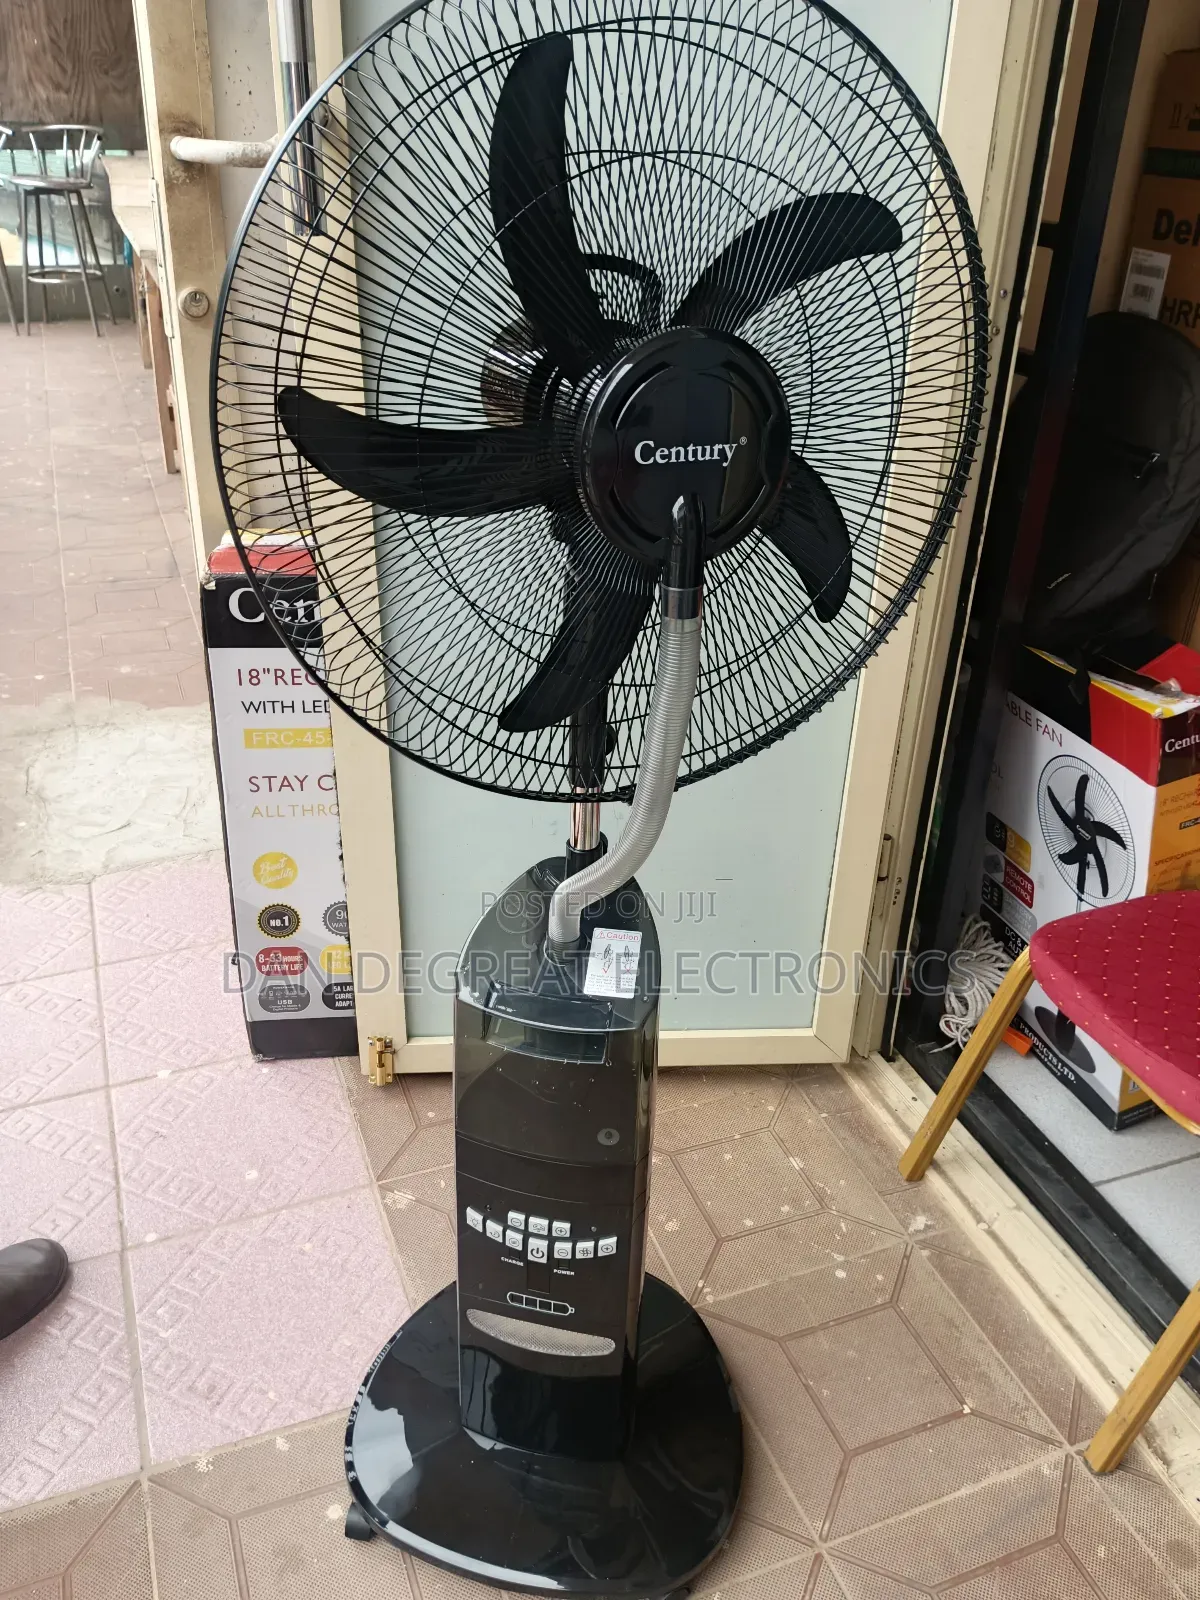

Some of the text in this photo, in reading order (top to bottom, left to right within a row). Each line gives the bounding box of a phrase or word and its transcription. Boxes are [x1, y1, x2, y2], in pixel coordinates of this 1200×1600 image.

[634, 440, 738, 467] Century
[241, 700, 295, 714] WITH
[1036, 717, 1063, 748] FAN
[248, 774, 334, 793] STAY C
[1006, 865, 1033, 893] REMOTE
[1005, 876, 1032, 904] CONTROL
[269, 915, 289, 927] NO.1
[606, 931, 639, 941] Caution
[1005, 926, 1016, 941] DC
[261, 964, 289, 972] BATTERY
[1019, 1022, 1077, 1084] PRODUCTS LTD.
[501, 1256, 525, 1267] CHARGE
[553, 1268, 575, 1276] POWER
